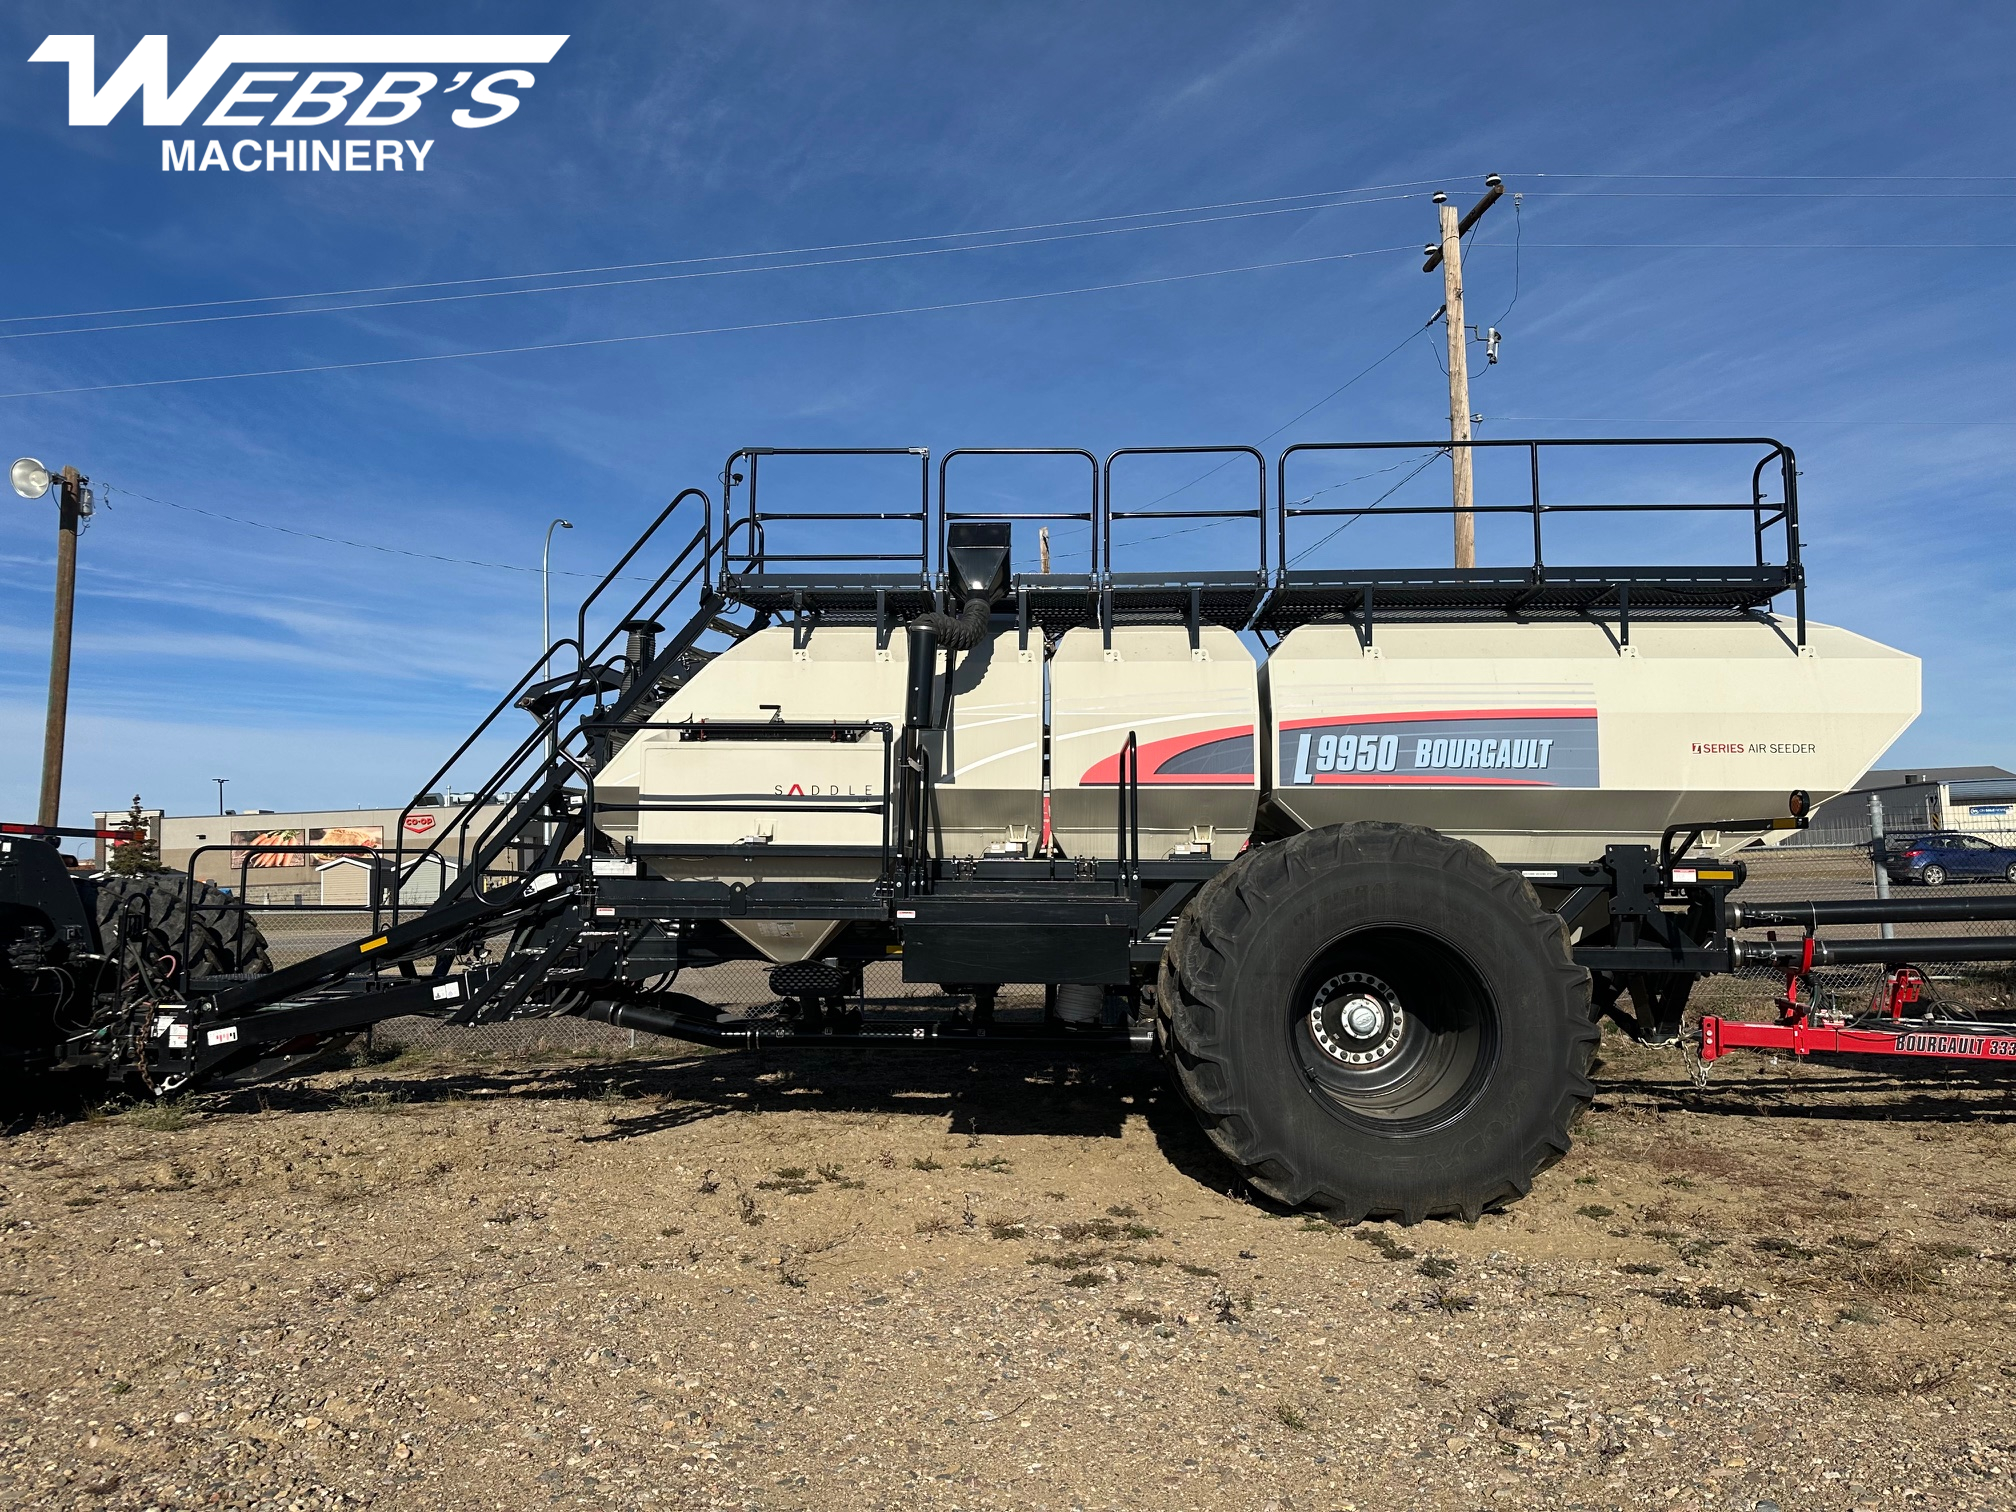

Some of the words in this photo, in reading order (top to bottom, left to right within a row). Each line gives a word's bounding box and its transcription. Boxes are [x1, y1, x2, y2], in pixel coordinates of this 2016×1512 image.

[1413, 738, 1555, 769] BOURGAULT
[1703, 743, 1745, 754] SERIES
[1748, 743, 1767, 754] AIR
[1769, 743, 1816, 754] SEEDER
[774, 783, 873, 796] SADDLE
[405, 817, 433, 826] CO-OP
[1895, 1034, 1984, 1055] BOURGAULT
